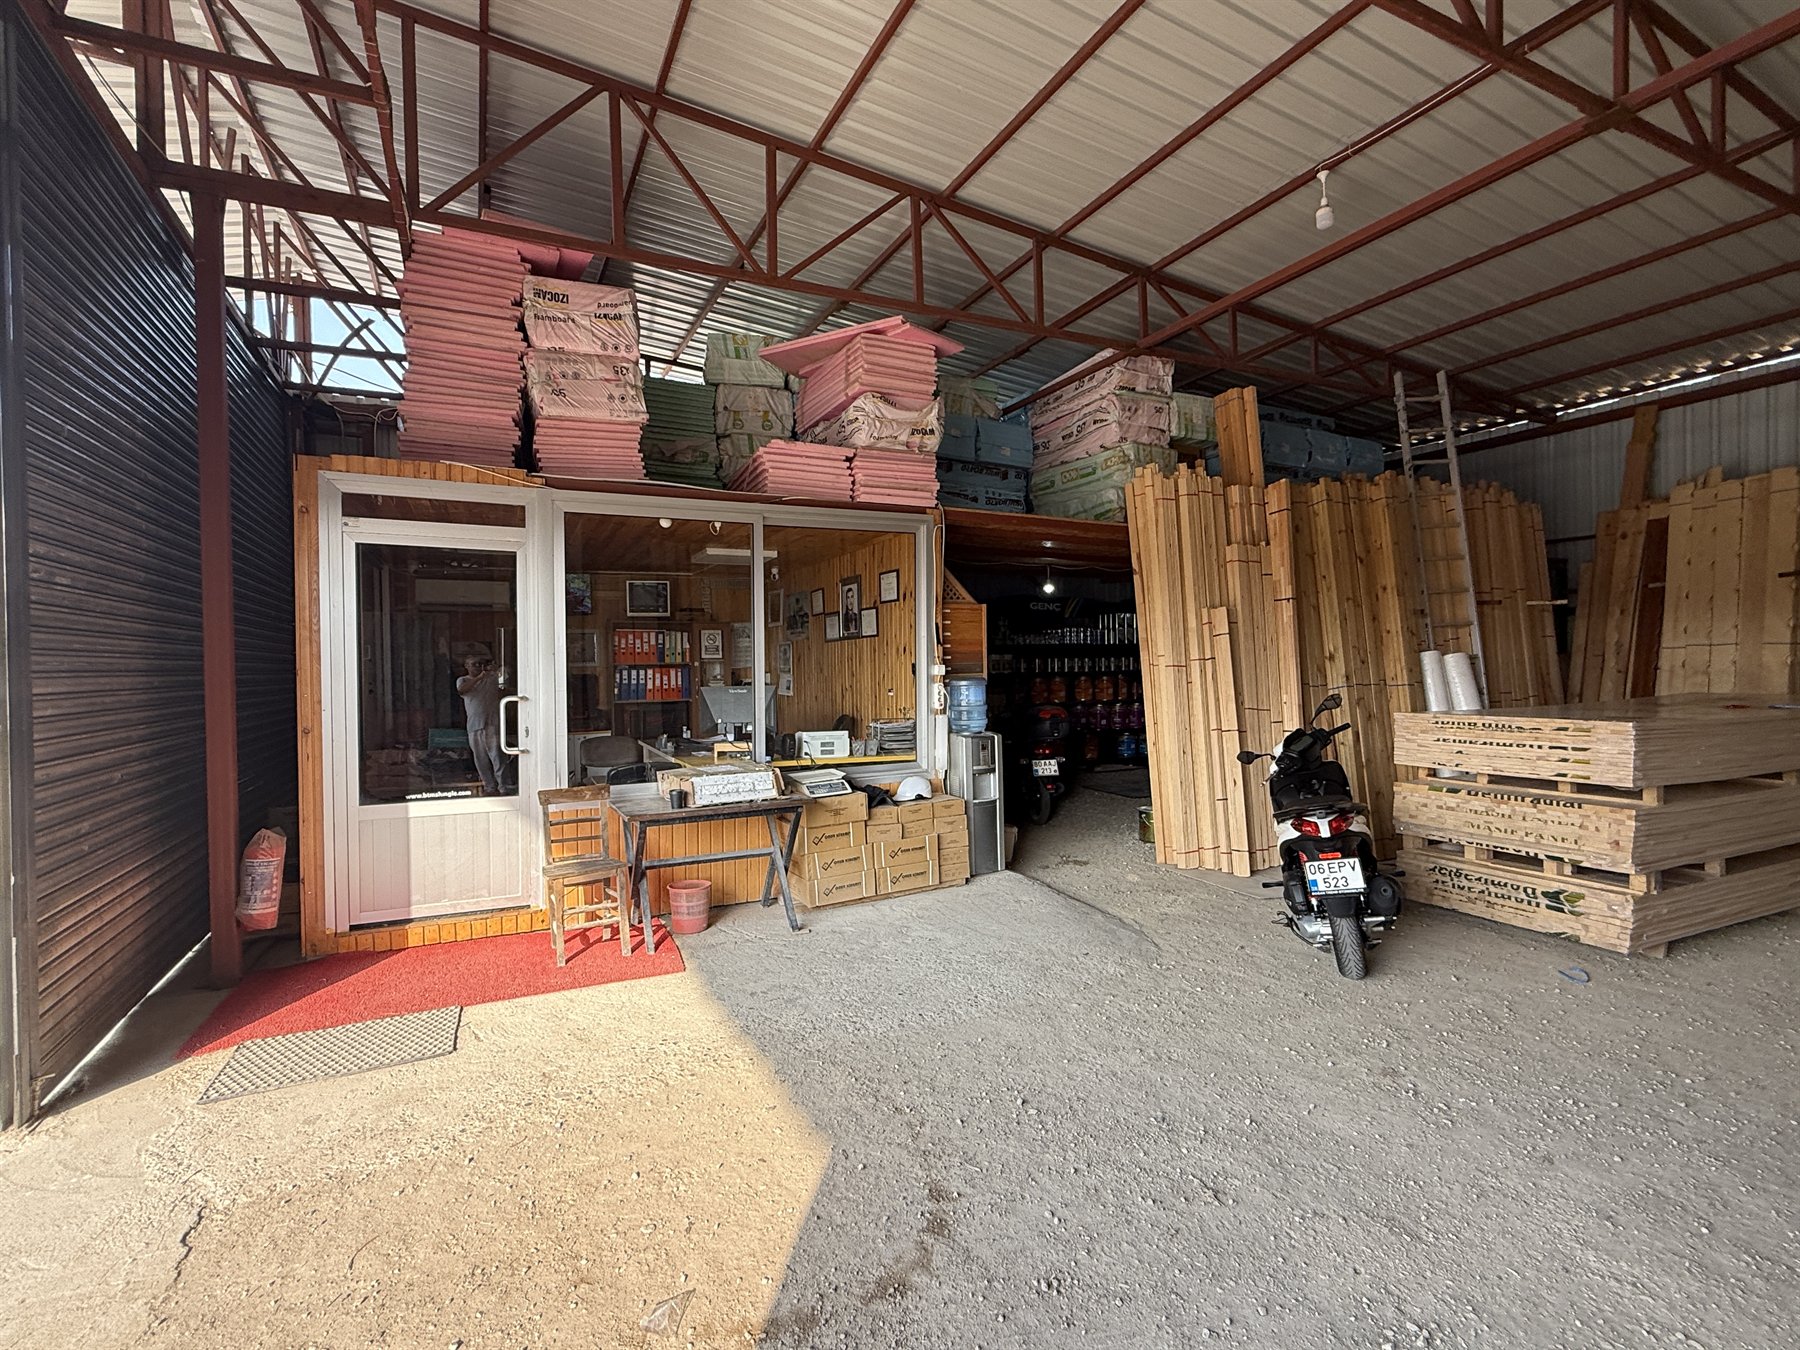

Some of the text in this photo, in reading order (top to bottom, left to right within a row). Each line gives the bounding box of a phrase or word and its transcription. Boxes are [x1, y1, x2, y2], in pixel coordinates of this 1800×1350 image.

[1308, 860, 1356, 875] 06 EPV
[1322, 875, 1349, 889] 523
